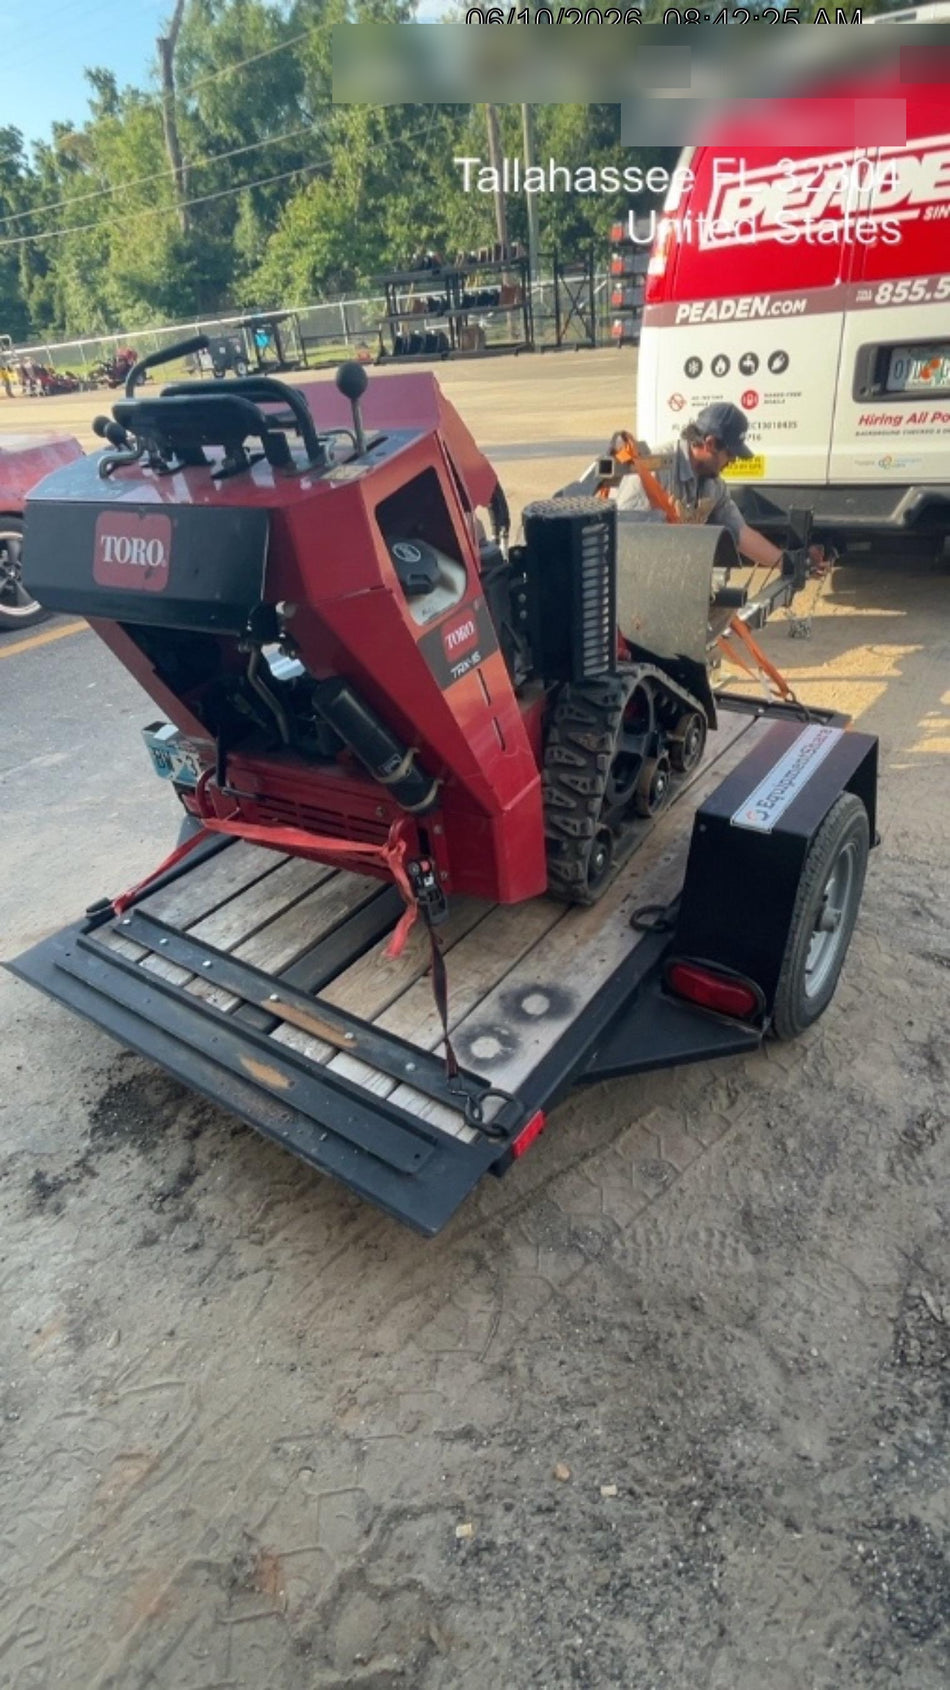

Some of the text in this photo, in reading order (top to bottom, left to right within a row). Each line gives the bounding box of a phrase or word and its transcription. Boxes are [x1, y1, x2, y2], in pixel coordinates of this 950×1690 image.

[675, 295, 807, 324] PEADEN.COM
[858, 412, 903, 427] Hiring
[906, 411, 928, 424] All
[101, 535, 165, 567] TORO
[444, 621, 475, 649] TORO
